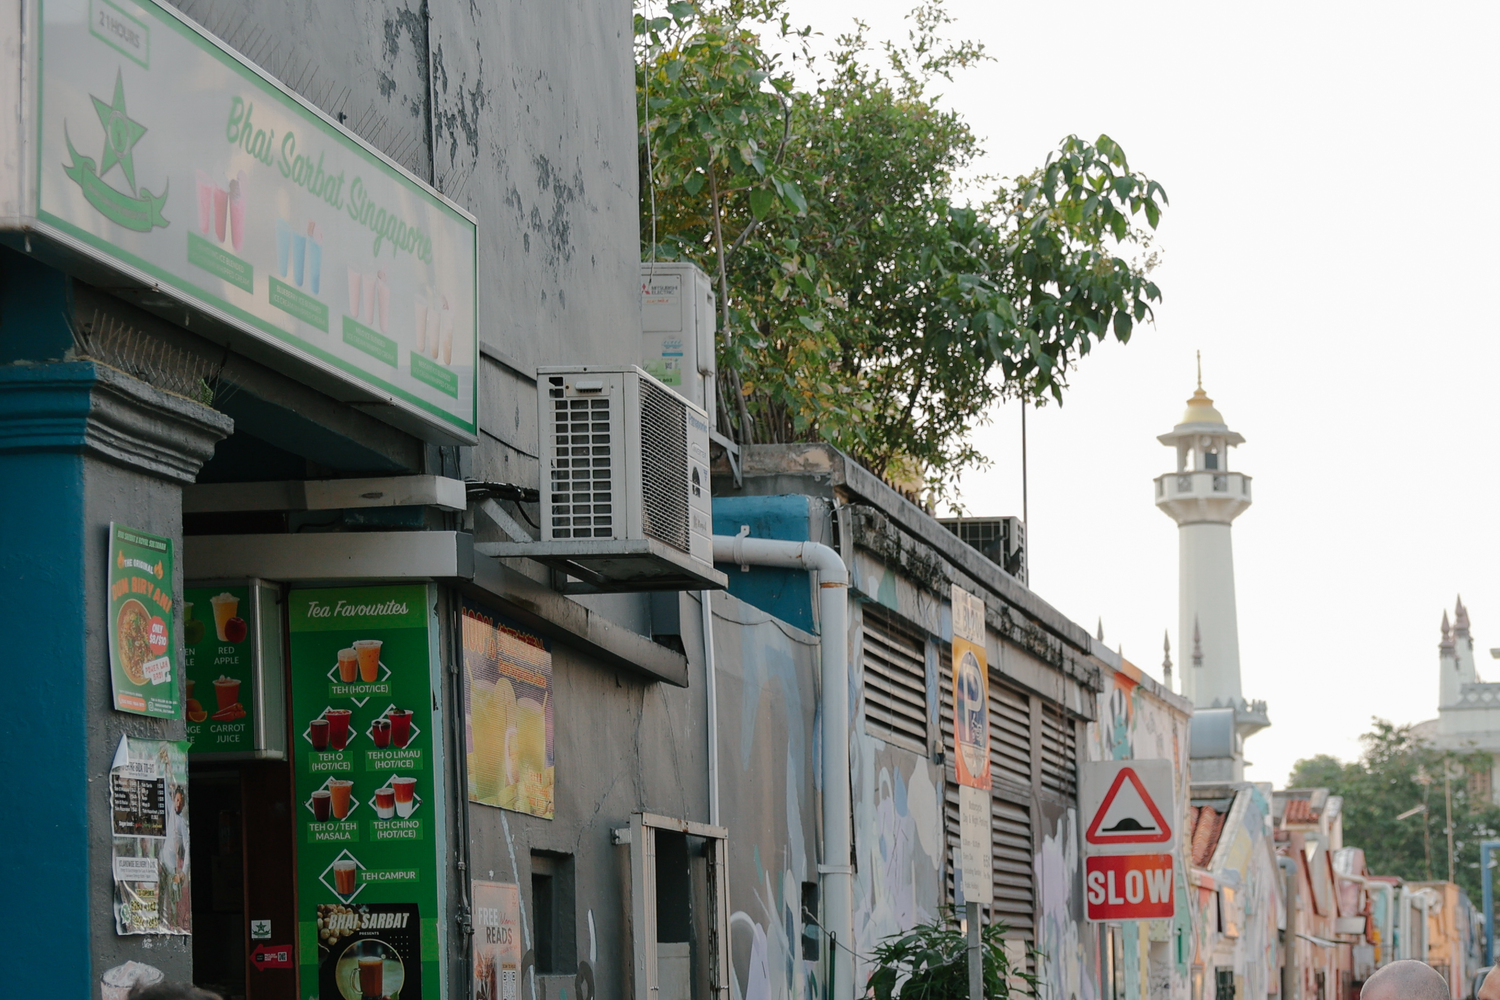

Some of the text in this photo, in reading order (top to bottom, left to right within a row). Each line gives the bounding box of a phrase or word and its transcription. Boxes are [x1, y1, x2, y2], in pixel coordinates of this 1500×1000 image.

[226, 95, 433, 265] Bhai Sarbat Singapore
[688, 411, 707, 432] Panasonic
[124, 558, 154, 575] THE ORIGINAL
[132, 576, 172, 614] BIRYANI
[307, 599, 409, 618] Tea Favourites
[218, 646, 234, 654] RED
[214, 656, 239, 665] APPLE
[332, 684, 389, 694] TEH (HOT/ICE)
[963, 662, 983, 742] P
[210, 724, 245, 733] CARROT
[216, 734, 240, 743] JUICE
[394, 750, 420, 758] LIMAU
[312, 762, 350, 772] (HOT/ICE)
[374, 760, 414, 769] (HOT/ICE)
[315, 832, 350, 840] MASALA
[377, 830, 416, 839] (HOT/ICE)
[379, 871, 416, 880] CAMPUR
[1087, 868, 1173, 906] SLOW
[328, 912, 410, 930] BHAI SARBAT
[478, 907, 498, 926] FREE
[486, 926, 512, 944] READS
